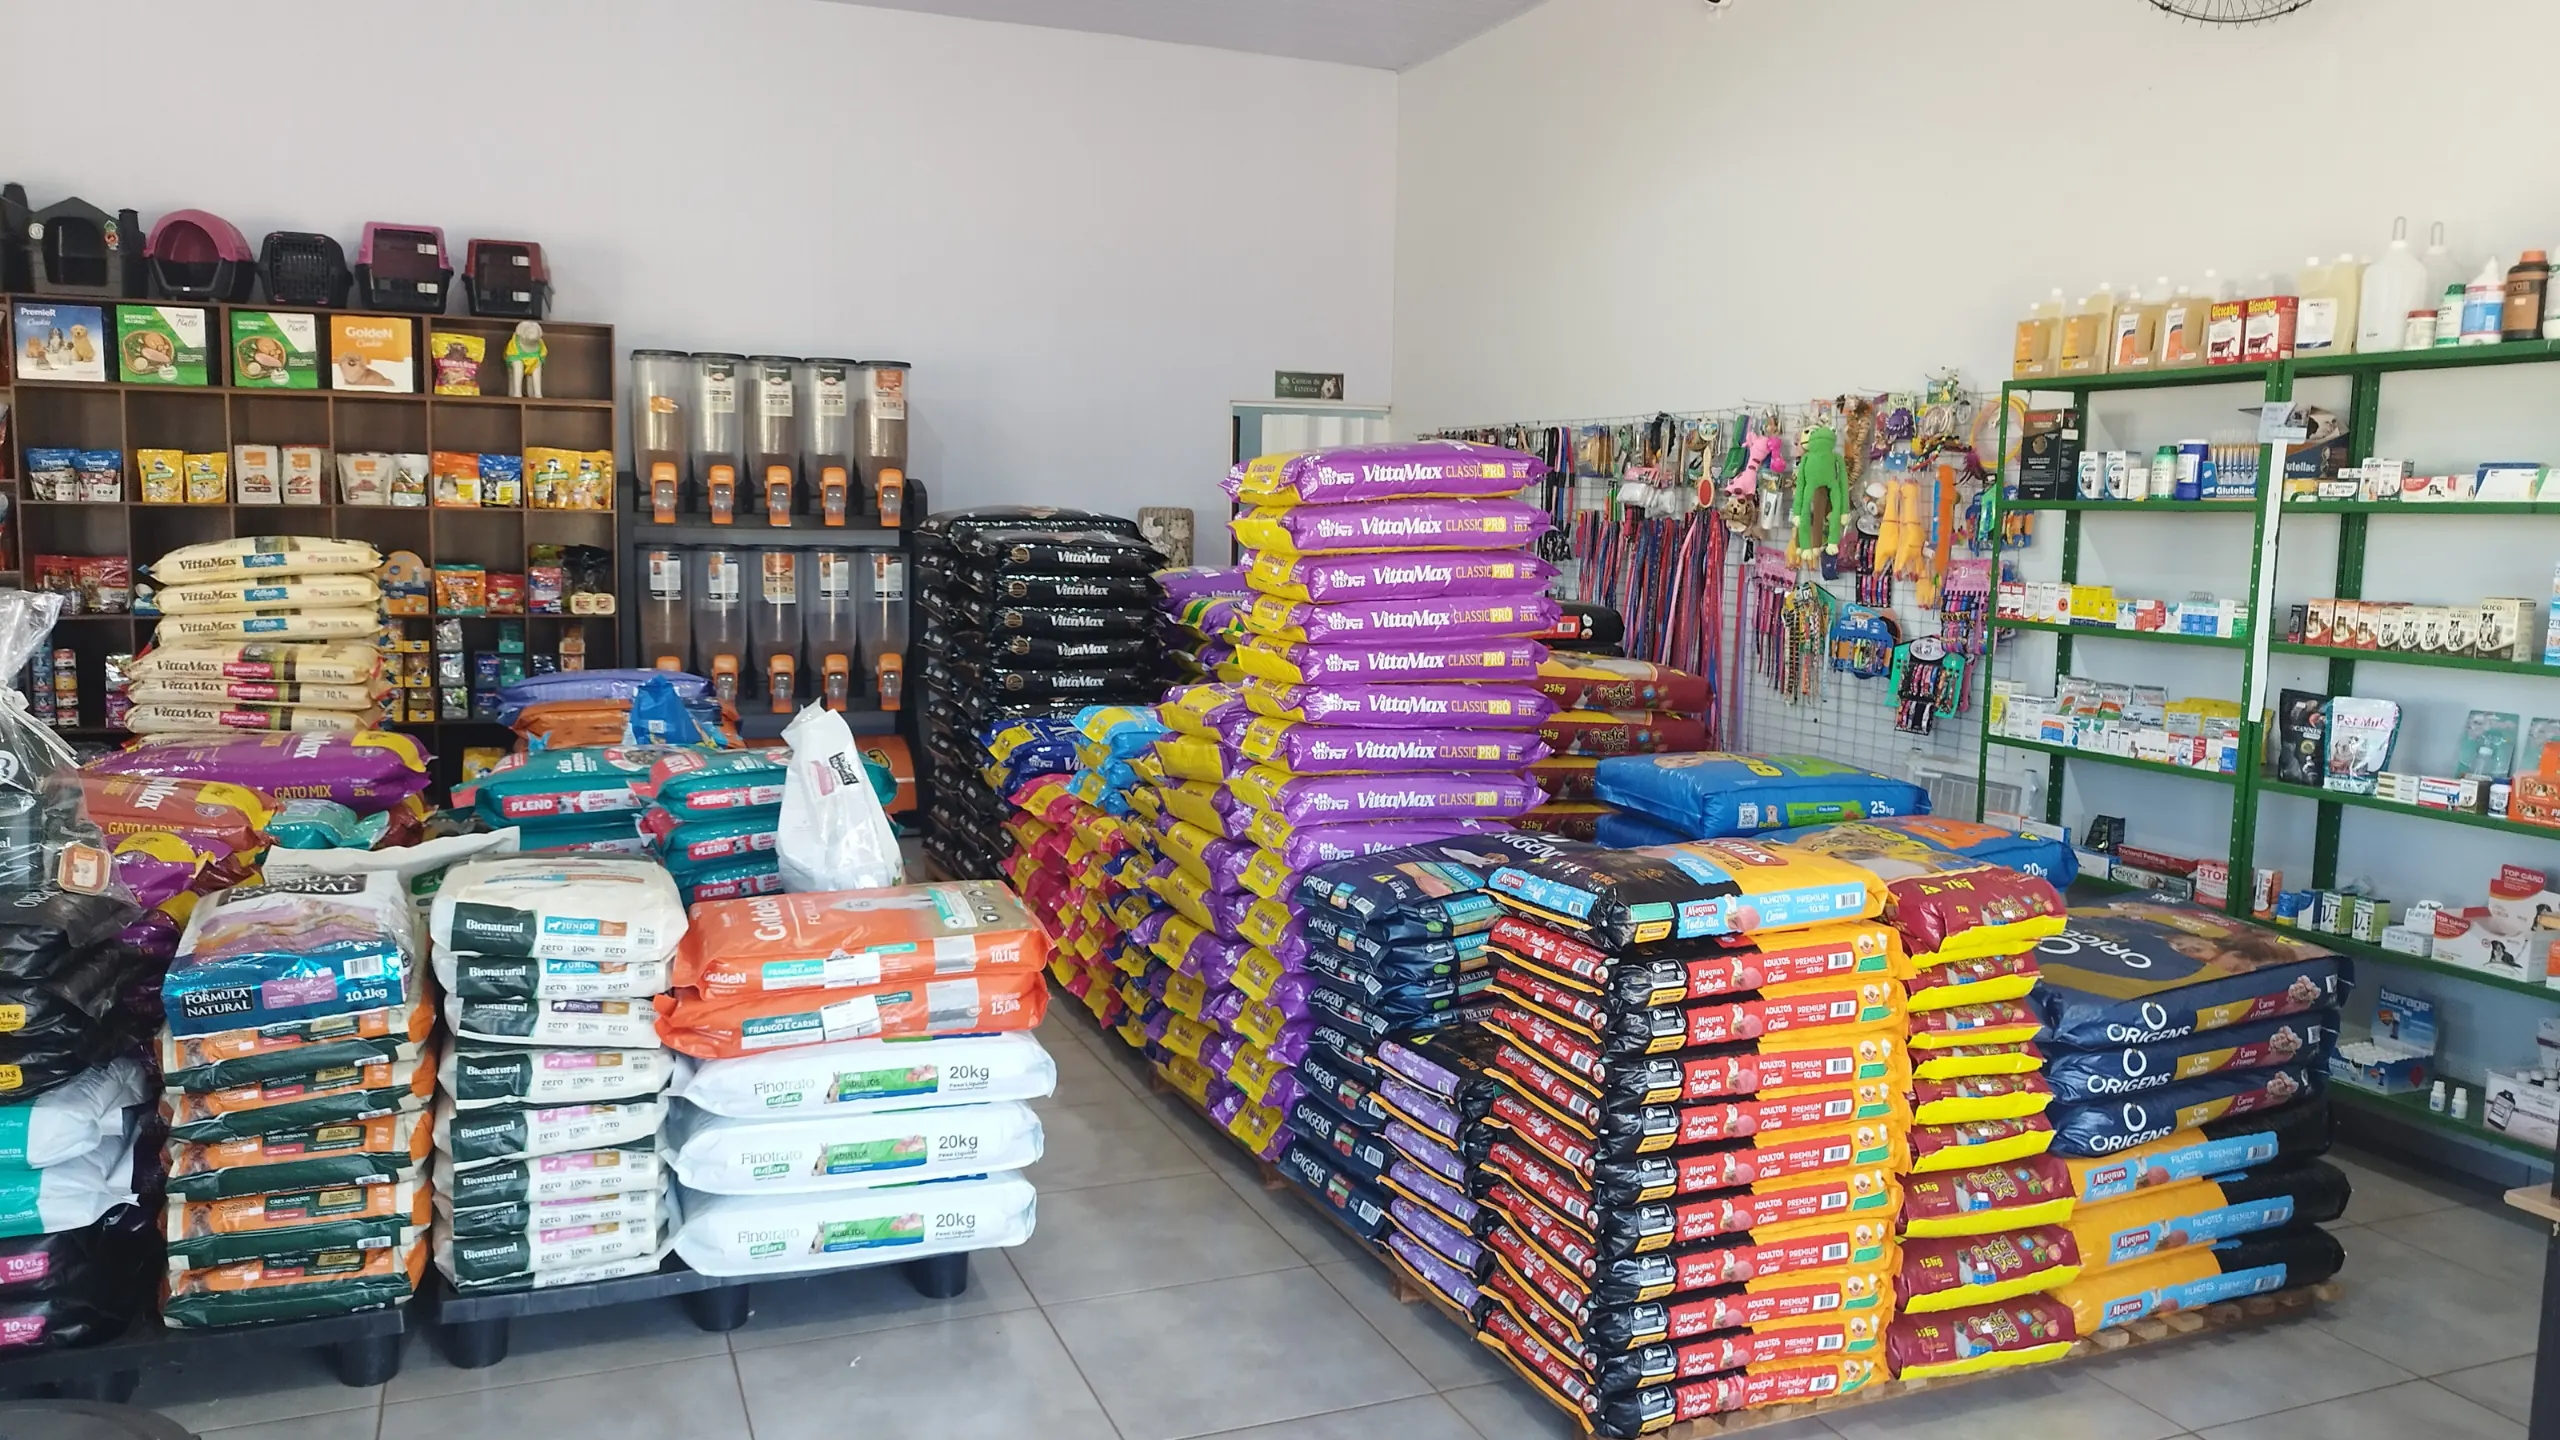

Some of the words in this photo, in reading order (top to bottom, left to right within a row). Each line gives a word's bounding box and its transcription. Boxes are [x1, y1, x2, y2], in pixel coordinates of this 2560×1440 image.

[21, 307, 56, 317] PremieR
[346, 326, 393, 340] GoldeN
[1362, 464, 1442, 483] VittaMax
[1446, 464, 1482, 478] CLASSIC
[1484, 464, 1505, 478] PRO
[2286, 461, 2316, 472] utellac
[2216, 486, 2255, 495] Glutellac
[1360, 516, 1442, 535] VittaMax
[1446, 518, 1482, 531] CLASSIC
[1484, 518, 1506, 531] PRO
[179, 558, 236, 570] VittaMax
[1057, 551, 1111, 564] VittaMax
[1051, 615, 1105, 627] VittaMax
[1370, 610, 1450, 629] VittaMax
[1454, 610, 1490, 623] CLASSIC
[1491, 609, 1513, 623] PRO
[180, 622, 237, 633] VittaMax
[1367, 653, 1445, 670] VittaMax
[1448, 653, 1483, 667] CLASSIC
[1484, 652, 1505, 666] PRO
[1544, 683, 1565, 695] 25kg
[1590, 725, 1629, 744] Pastel
[274, 787, 306, 799] GATO
[308, 785, 332, 798] MIX
[511, 800, 553, 812] PLENO
[1871, 801, 1894, 815] 25kg
[108, 822, 141, 835] GATO
[1521, 820, 1542, 831] 25kg
[695, 843, 729, 855] PLENO
[2023, 863, 2048, 877] 20kg
[2504, 869, 2519, 877] TOP
[2521, 872, 2544, 883] GARD
[701, 884, 735, 898] PLENO
[1303, 875, 1333, 899] ORIGENS
[1760, 894, 1791, 904] FILHOTES
[466, 919, 523, 933] Bionatural
[561, 921, 595, 930] JUNIOR
[1307, 915, 1337, 937] ORIGENS
[1684, 918, 1705, 930] Todo
[1707, 916, 1719, 928] dia
[2437, 915, 2448, 923] TOP
[1499, 921, 1527, 940] Magnus
[1764, 957, 1791, 967] ADULTOS
[469, 966, 526, 977] Bionatural
[703, 972, 746, 984] GoldeN
[768, 967, 795, 976] FRANGO
[1695, 982, 1713, 994] Todo
[1714, 978, 1726, 990] dia
[185, 989, 249, 1005] FÓRMULA
[346, 988, 387, 1002] 10,1kg
[2380, 990, 2430, 1012] barrage
[186, 1000, 251, 1017] NATURAL
[1765, 1004, 1792, 1015] ADULTOS
[2258, 999, 2275, 1009] Carne
[748, 1022, 784, 1034] FRANGO
[786, 1022, 791, 1030] E
[792, 1019, 820, 1030] CARNE
[1694, 1030, 1713, 1042] Todo
[1714, 1026, 1726, 1038] dia
[466, 1064, 520, 1076] Bionatural
[949, 1065, 990, 1081] 20kg
[1304, 1057, 1337, 1090] ORIGENS
[542, 1078, 563, 1086] zero
[572, 1076, 595, 1084] 100%
[754, 1077, 815, 1095] Finotrato
[1690, 1081, 1708, 1093] Todo
[1709, 1079, 1722, 1090] dia
[2087, 1072, 2172, 1094] ORIGENS
[1496, 1096, 1527, 1117] Magnus
[1297, 1104, 1331, 1136] ORIGENS
[460, 1122, 515, 1138] Bionatural
[939, 1134, 978, 1151] 20kg
[2089, 1126, 2172, 1151] ORIGENS
[741, 1149, 802, 1165] Finotrato
[2171, 1150, 2204, 1164] FILHOTES
[2209, 1146, 2242, 1160] PREMIUM
[462, 1171, 517, 1186] Bionatural
[1968, 1166, 2007, 1190] Pastel
[2094, 1168, 2127, 1184] Magnus
[1913, 1182, 1940, 1194] 15kg
[1990, 1182, 2018, 1200] Dog
[540, 1216, 561, 1224] zero
[570, 1213, 591, 1221] 100%
[600, 1210, 621, 1218] zero
[936, 1213, 976, 1229] 20kg
[1757, 1212, 1778, 1225] Carne
[2192, 1213, 2223, 1227] FILHOTES
[2227, 1210, 2258, 1224] PREMIUM
[738, 1227, 799, 1243] Finotrato
[1496, 1225, 1521, 1249] Magnus
[2118, 1231, 2149, 1247] Magnus
[463, 1243, 518, 1259] Bionatural
[541, 1252, 562, 1261] zero
[571, 1247, 592, 1256] 100%
[601, 1241, 622, 1251] zero
[1756, 1248, 1784, 1261] ADULTOS
[1789, 1247, 1819, 1258] PREMIUM
[1971, 1236, 2012, 1262] Pastel
[1919, 1257, 1944, 1269] 15kg
[1994, 1251, 2022, 1273] Dog
[2184, 1283, 2214, 1296] FILHOTES
[2219, 1278, 2250, 1291] PREMIUM
[1748, 1297, 1775, 1309] ADULTOS
[1779, 1296, 1809, 1307] PREMIUM
[2111, 1300, 2142, 1315] Magnus
[1994, 1323, 2018, 1346] Dog
[1754, 1338, 1780, 1349] ADULTOS
